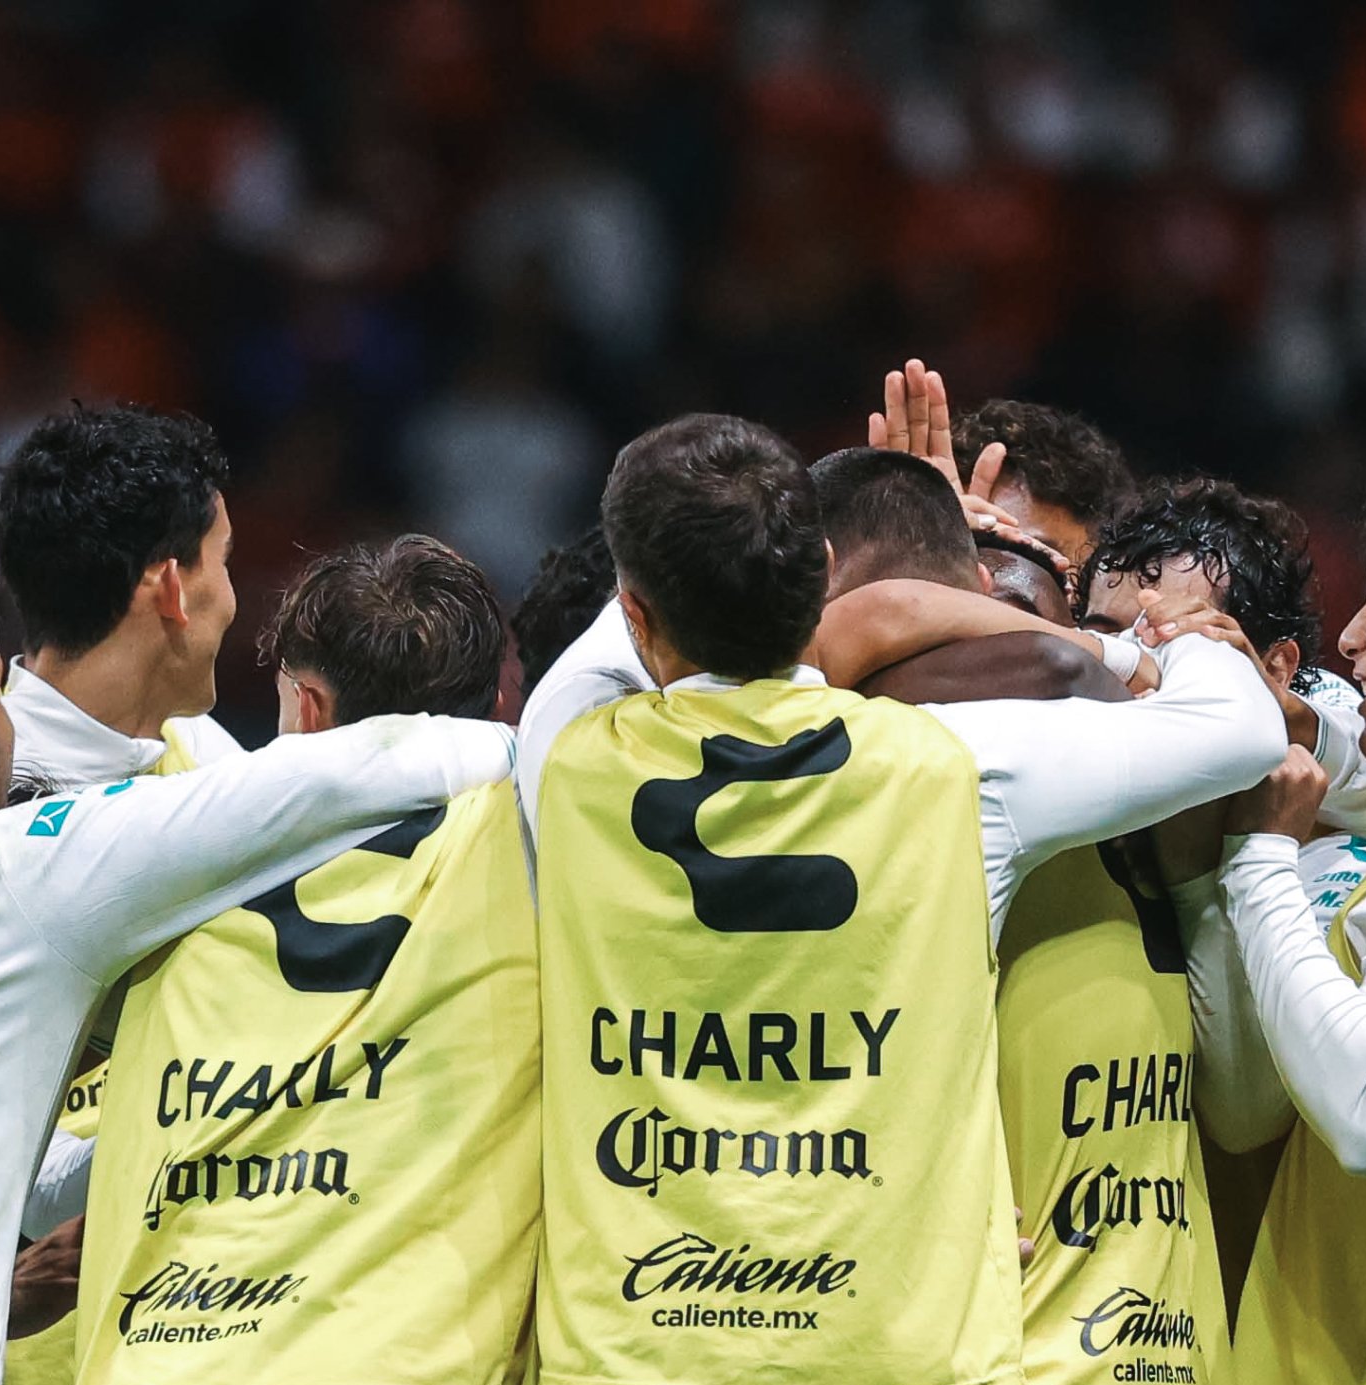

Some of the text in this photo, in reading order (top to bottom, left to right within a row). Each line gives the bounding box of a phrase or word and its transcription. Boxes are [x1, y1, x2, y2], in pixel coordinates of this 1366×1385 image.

[590, 1007, 901, 1081] CHARLY
[1062, 1053, 1195, 1139] CHARL
[596, 1106, 873, 1197] Corona
[1052, 1163, 1189, 1253] Coron
[621, 1232, 857, 1302] Caliente
[126, 1317, 263, 1346] caliente.mx
[651, 1305, 818, 1330] caliente.mx
[1070, 1287, 1196, 1357] Caliente
[1114, 1358, 1196, 1384] caliente.mx
